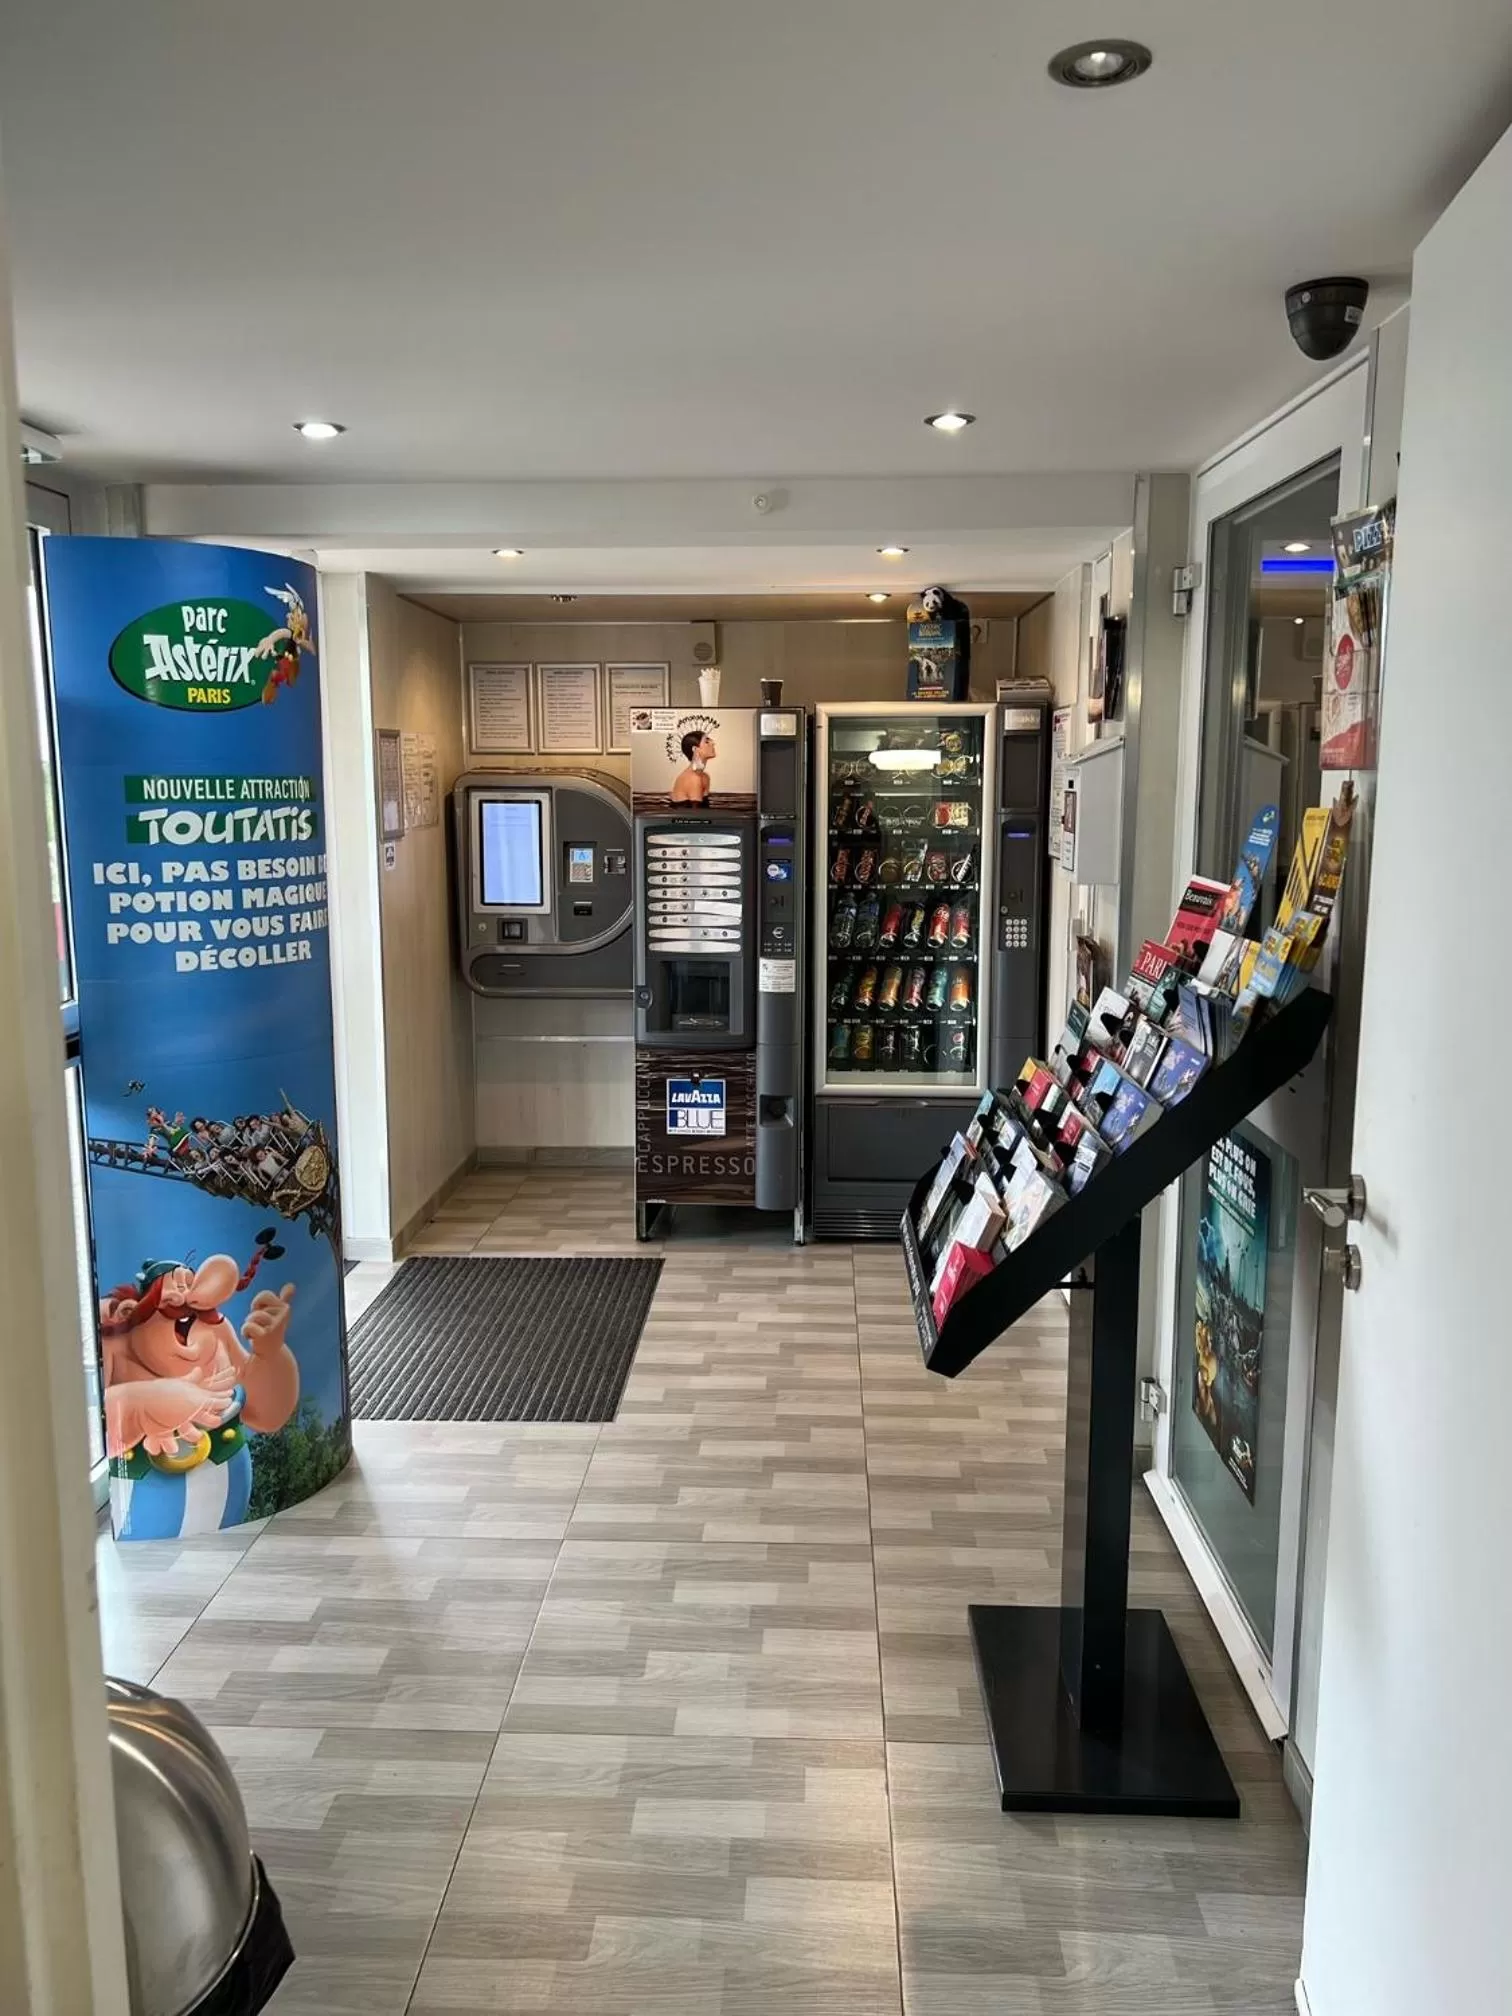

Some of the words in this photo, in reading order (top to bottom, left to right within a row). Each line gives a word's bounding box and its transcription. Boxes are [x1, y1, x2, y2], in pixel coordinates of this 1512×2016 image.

[143, 634, 257, 685] Astérix
[187, 687, 231, 704] PARIS
[143, 779, 236, 800] NOUVELLE
[240, 777, 310, 802] ATTRACTION
[92, 862, 153, 887] ICI,
[161, 860, 230, 884] PAS
[237, 855, 316, 881] BESOIN
[109, 888, 234, 915] POTION
[242, 880, 328, 909] MAGIQUE
[107, 919, 204, 945] POUR
[210, 913, 285, 941] VOUS
[175, 940, 312, 973] DÉCOLLER
[1139, 951, 1170, 980] PARI
[677, 1108, 725, 1129] BLUE
[637, 1155, 757, 1176] ESPRESSO
